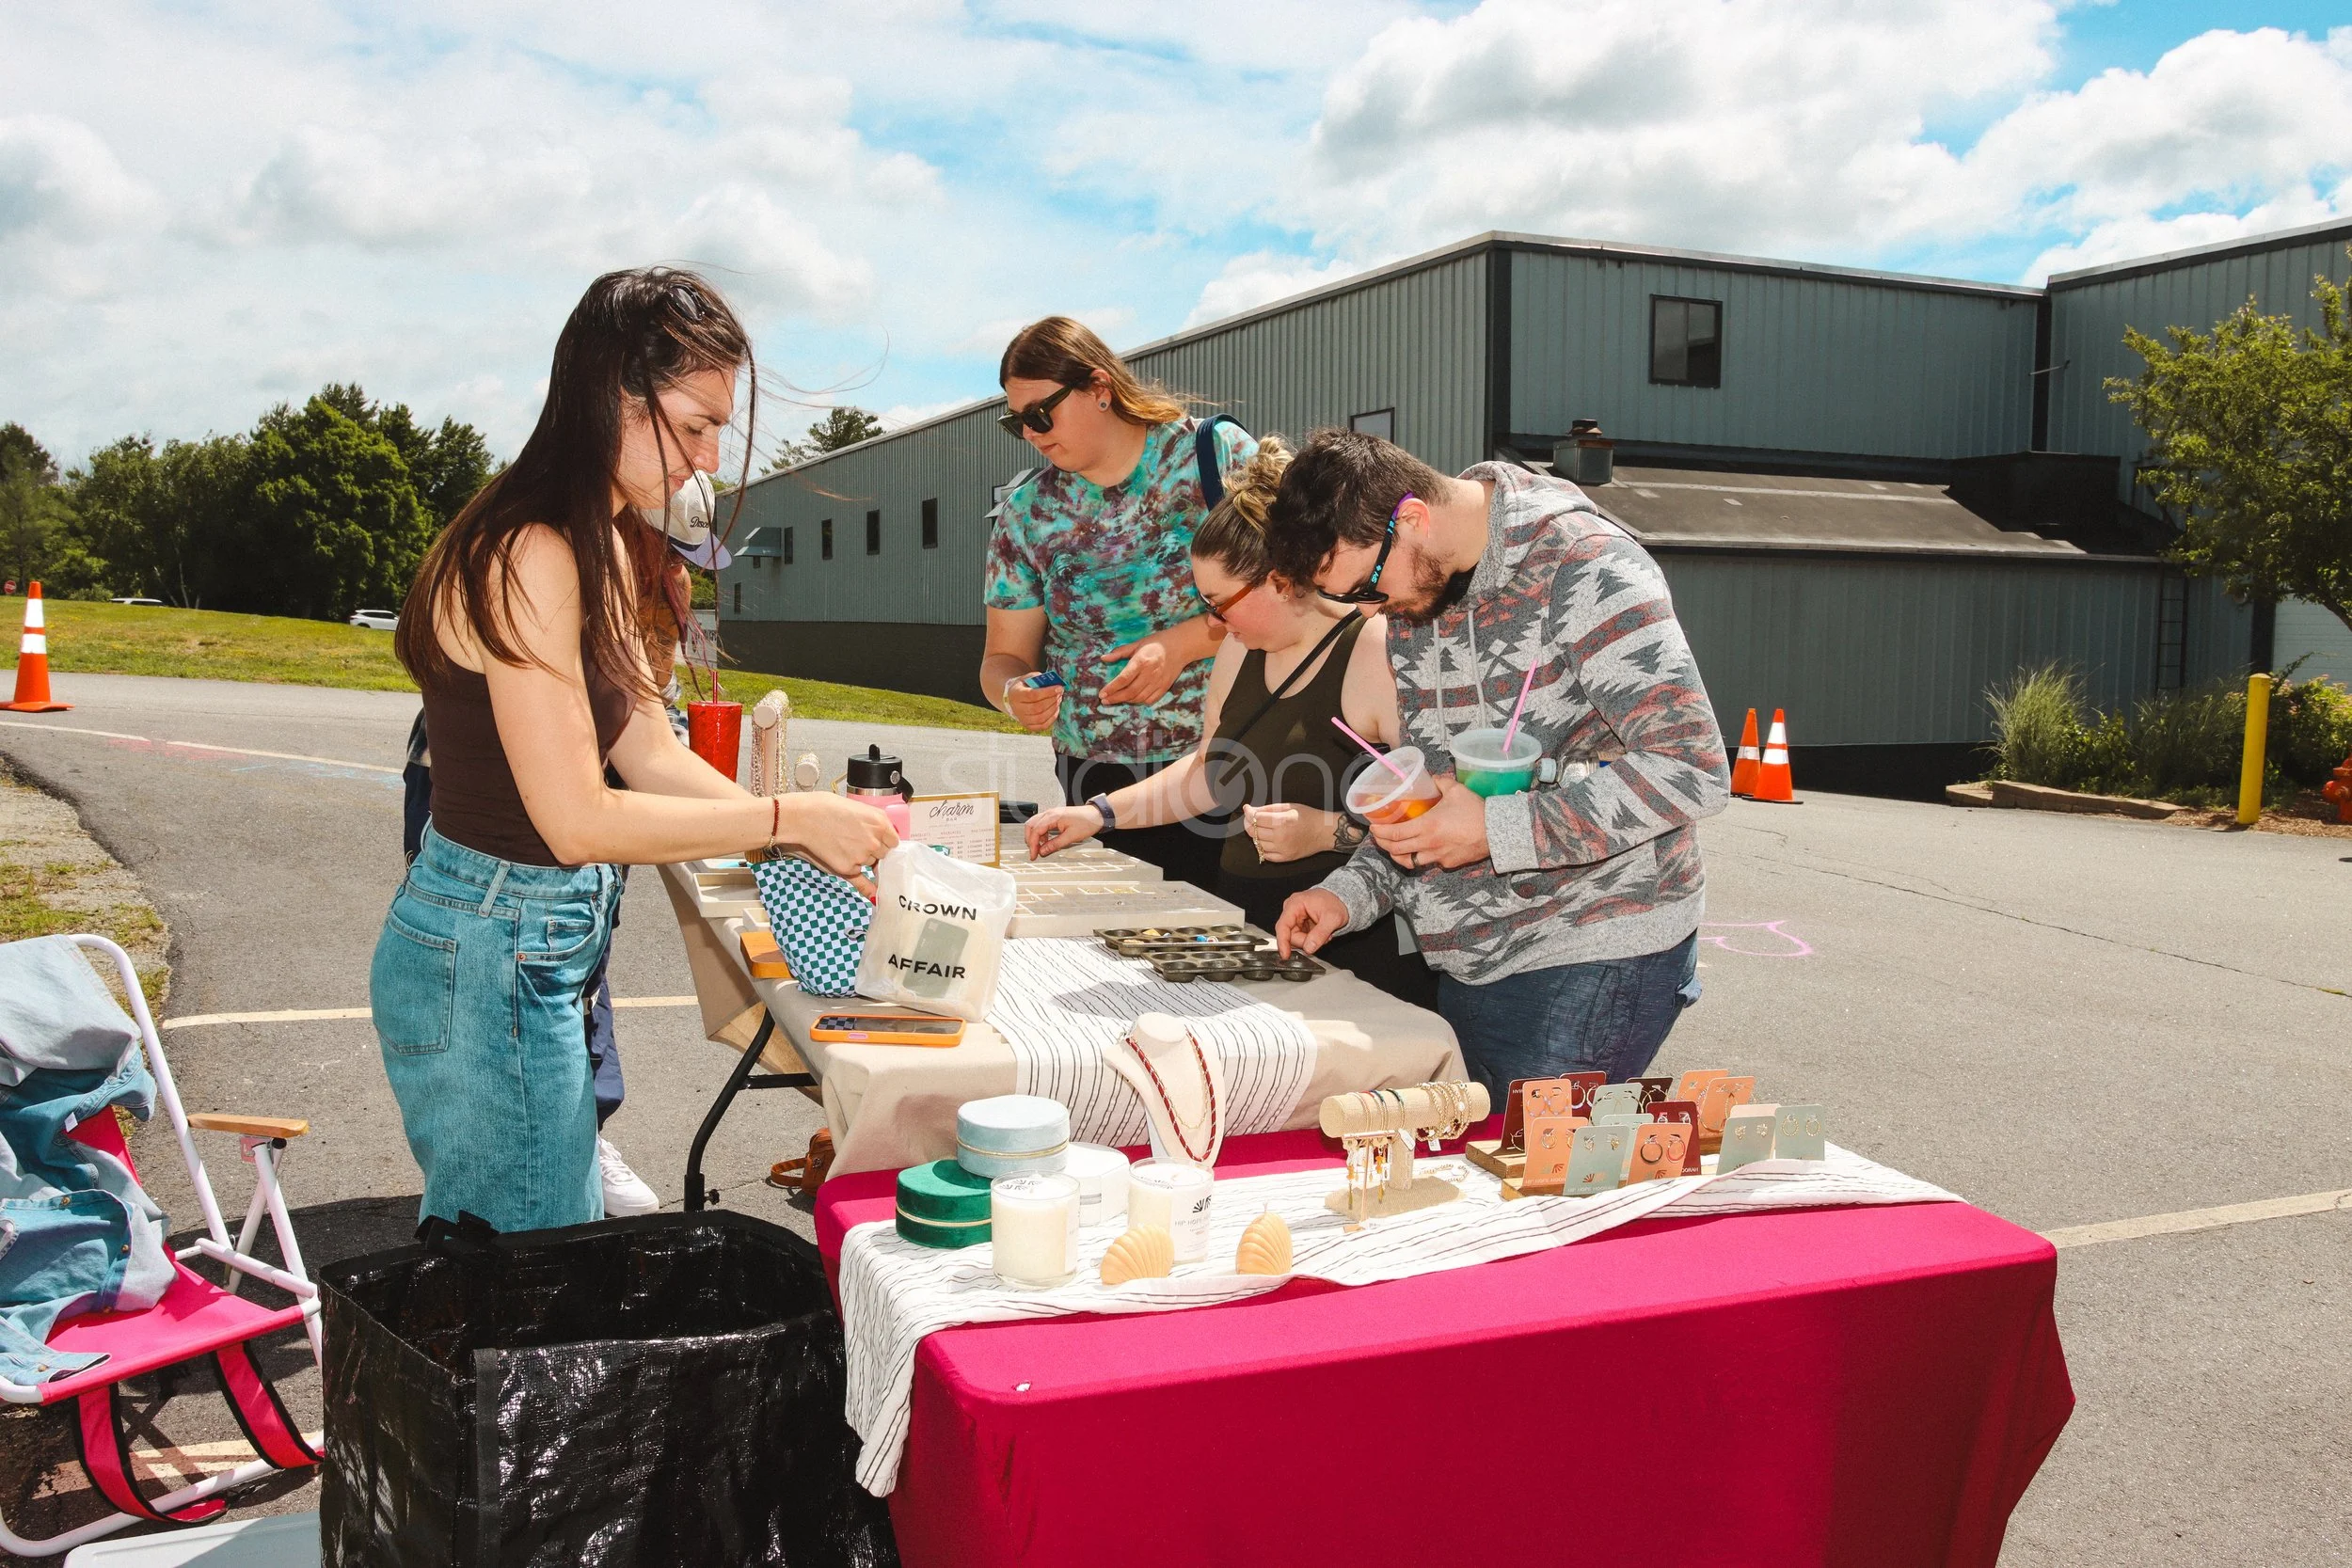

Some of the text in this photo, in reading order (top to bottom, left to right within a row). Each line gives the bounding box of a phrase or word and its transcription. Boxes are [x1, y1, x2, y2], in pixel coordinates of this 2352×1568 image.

[1371, 571, 1379, 584] SPY
[929, 800, 975, 818] charm
[898, 895, 977, 921] CROWN
[887, 954, 966, 979] AFFAIR
